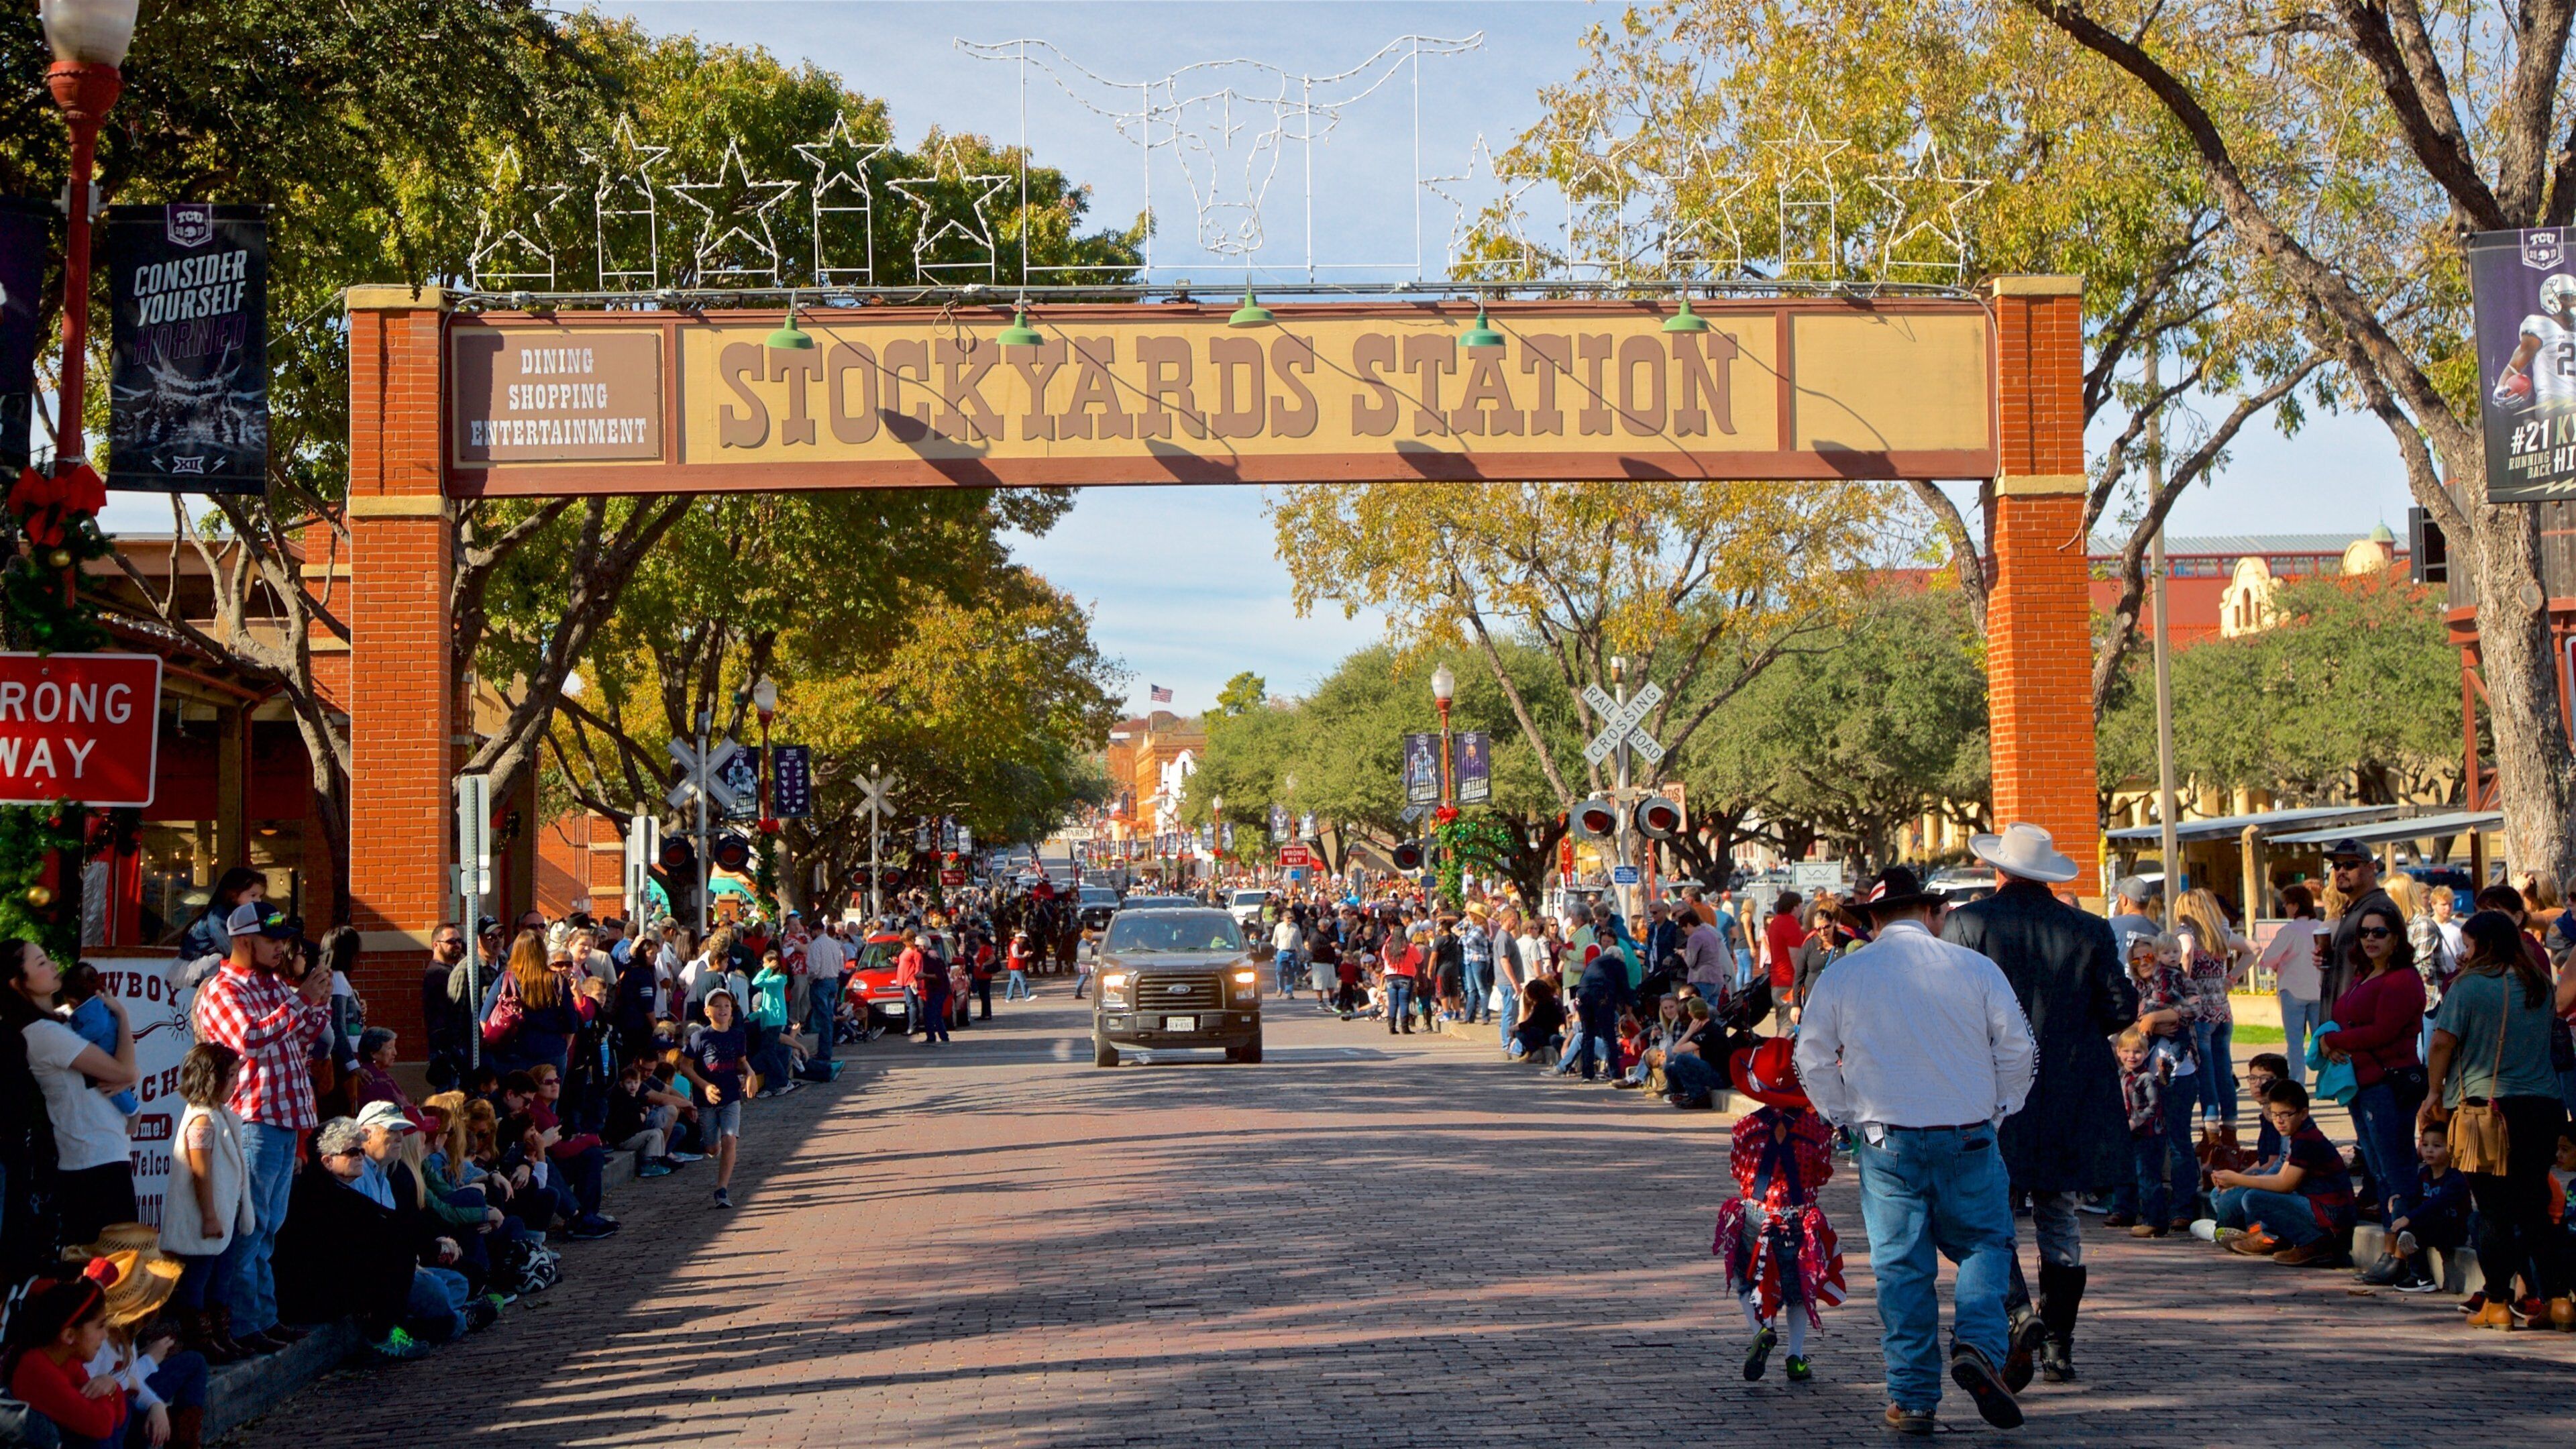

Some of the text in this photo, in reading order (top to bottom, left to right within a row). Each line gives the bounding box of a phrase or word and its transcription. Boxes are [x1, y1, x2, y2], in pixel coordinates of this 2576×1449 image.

[177, 211, 203, 223] TCU
[2530, 232, 2555, 246] TCU
[134, 250, 247, 297] CONSIDER
[138, 281, 246, 327] YOURSELF
[134, 313, 247, 365] HORNED
[521, 347, 594, 374] DINING
[508, 383, 608, 411] SHOPPING
[720, 333, 1738, 448] STOCKYARDS STATION
[471, 418, 646, 446] ENTERTAINMENT
[2510, 419, 2549, 455] #21
[2508, 451, 2550, 470] RUNNING
[2527, 463, 2551, 479] BACK
[1586, 686, 1660, 759] RAIL ROAD
[1591, 688, 1656, 757] CROSSING
[130, 1065, 180, 1102] CH
